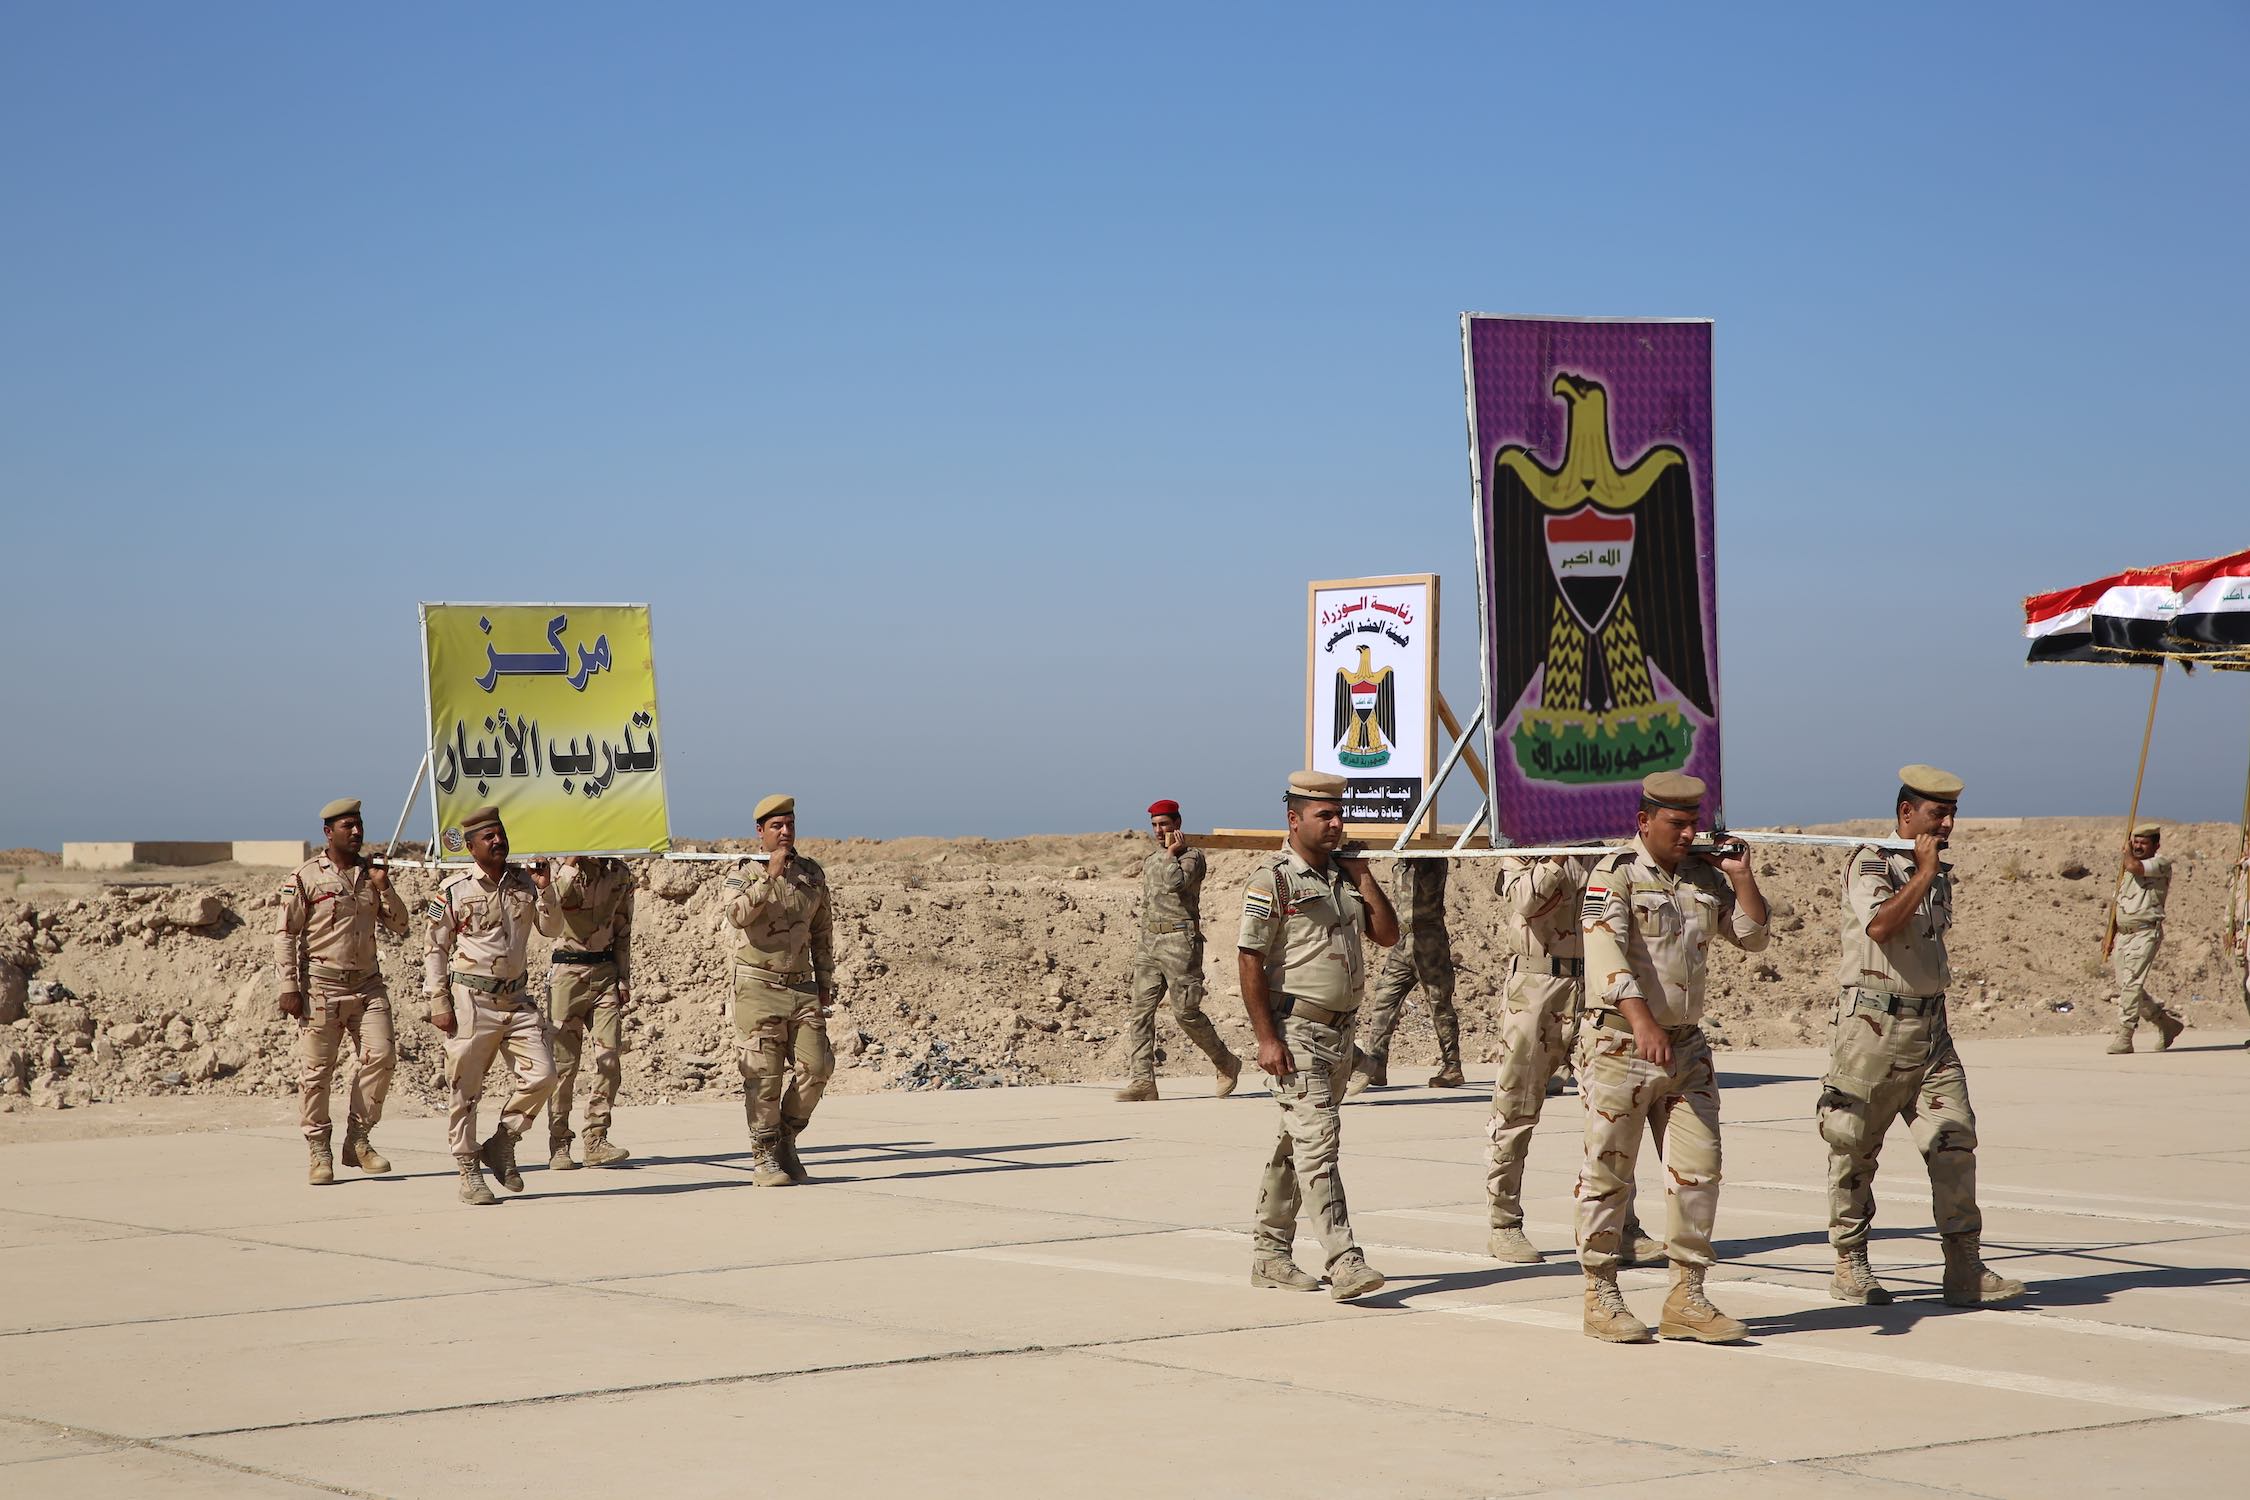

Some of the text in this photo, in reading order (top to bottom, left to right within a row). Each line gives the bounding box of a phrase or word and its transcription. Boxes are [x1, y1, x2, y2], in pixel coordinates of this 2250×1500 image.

[1599, 549, 1620, 566] الله
[1321, 595, 1413, 627] رئاسة الوزراء
[1324, 618, 1410, 654] هيئة الحشد الشعبي
[474, 613, 612, 693] مركز
[436, 707, 658, 798] تدريب الأنبار
[1354, 785, 1384, 799] الحشد
[1385, 785, 1411, 802] لجنة
[1350, 805, 1379, 818] محافظة
[1380, 805, 1403, 821] قيادة
